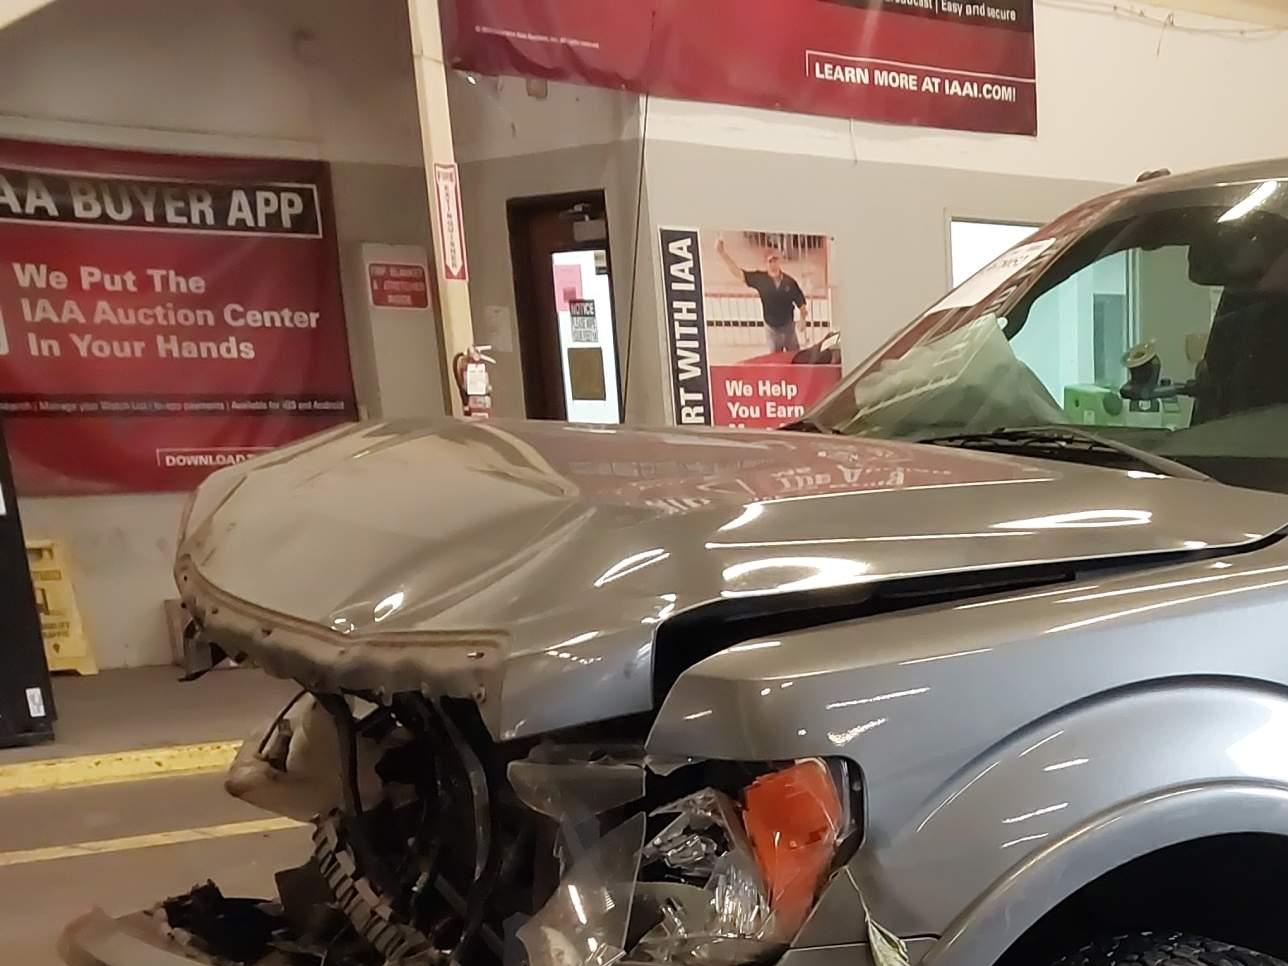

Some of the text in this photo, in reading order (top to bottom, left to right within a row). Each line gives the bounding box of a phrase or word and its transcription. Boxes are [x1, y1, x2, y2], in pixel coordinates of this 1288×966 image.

[965, 3, 987, 17] and
[987, 7, 1017, 22] secure
[814, 61, 1017, 103] LEARN MORE AT IAAI.COM!
[70, 181, 215, 227] BUYER
[227, 189, 305, 229] APP
[12, 263, 207, 295] We Put The
[667, 237, 696, 291] IAA
[20, 300, 320, 329] IAA Auction Center
[27, 332, 256, 360] In Your Hands
[673, 301, 702, 381] WITH
[725, 380, 798, 399] We Help
[728, 403, 805, 419] You Earn
